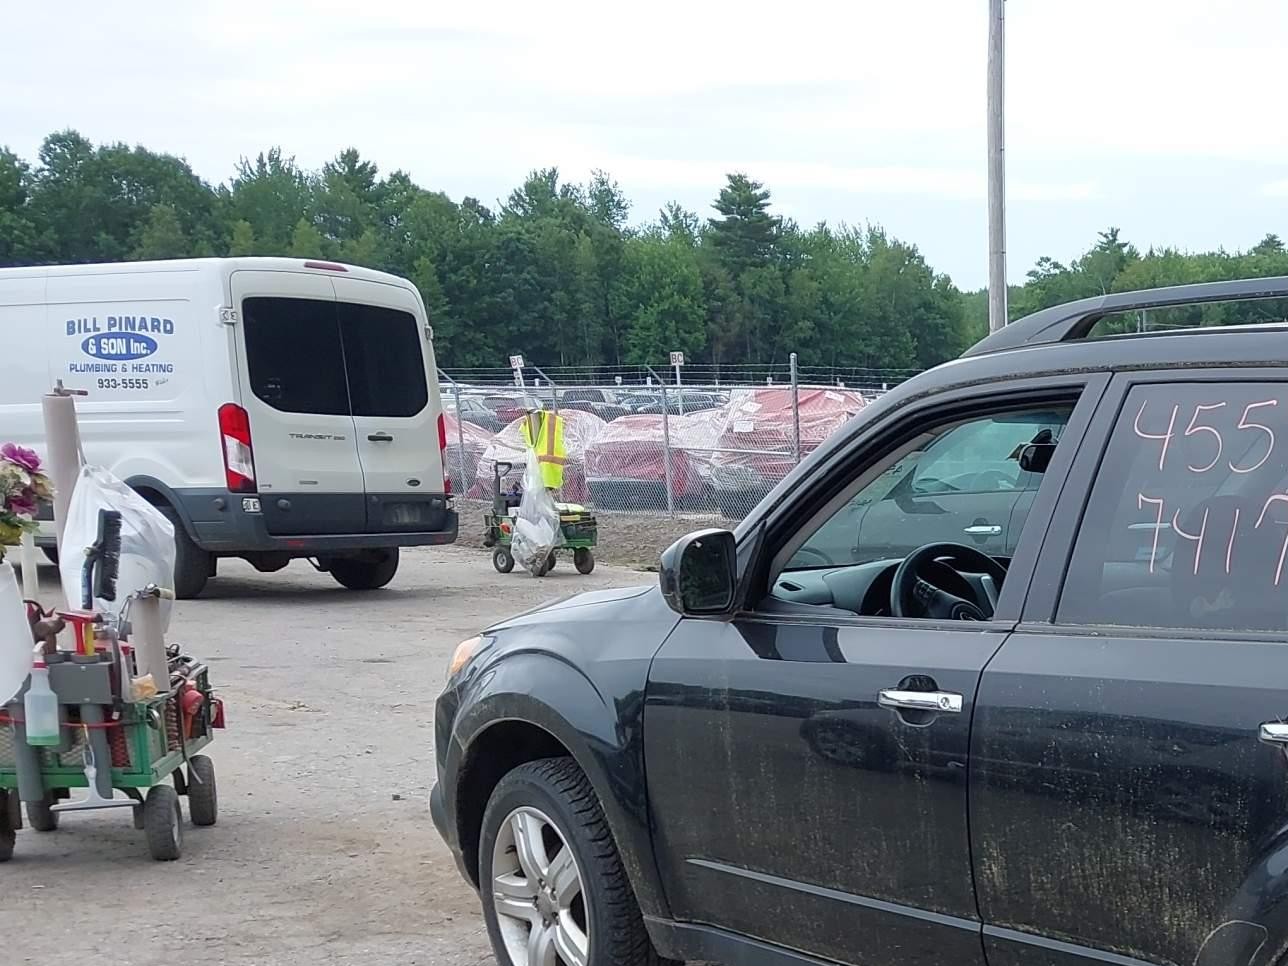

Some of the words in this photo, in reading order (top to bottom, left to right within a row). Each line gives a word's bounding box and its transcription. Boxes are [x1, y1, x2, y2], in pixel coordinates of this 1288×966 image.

[66, 317, 101, 336] BILL
[107, 316, 174, 335] PINARD
[88, 338, 97, 354] &
[101, 338, 127, 354] SON
[130, 338, 151, 354] Inc.
[69, 363, 117, 373] PLUMBING
[121, 363, 128, 373] &
[132, 363, 173, 373] HEATING
[97, 378, 149, 389] 933-5555
